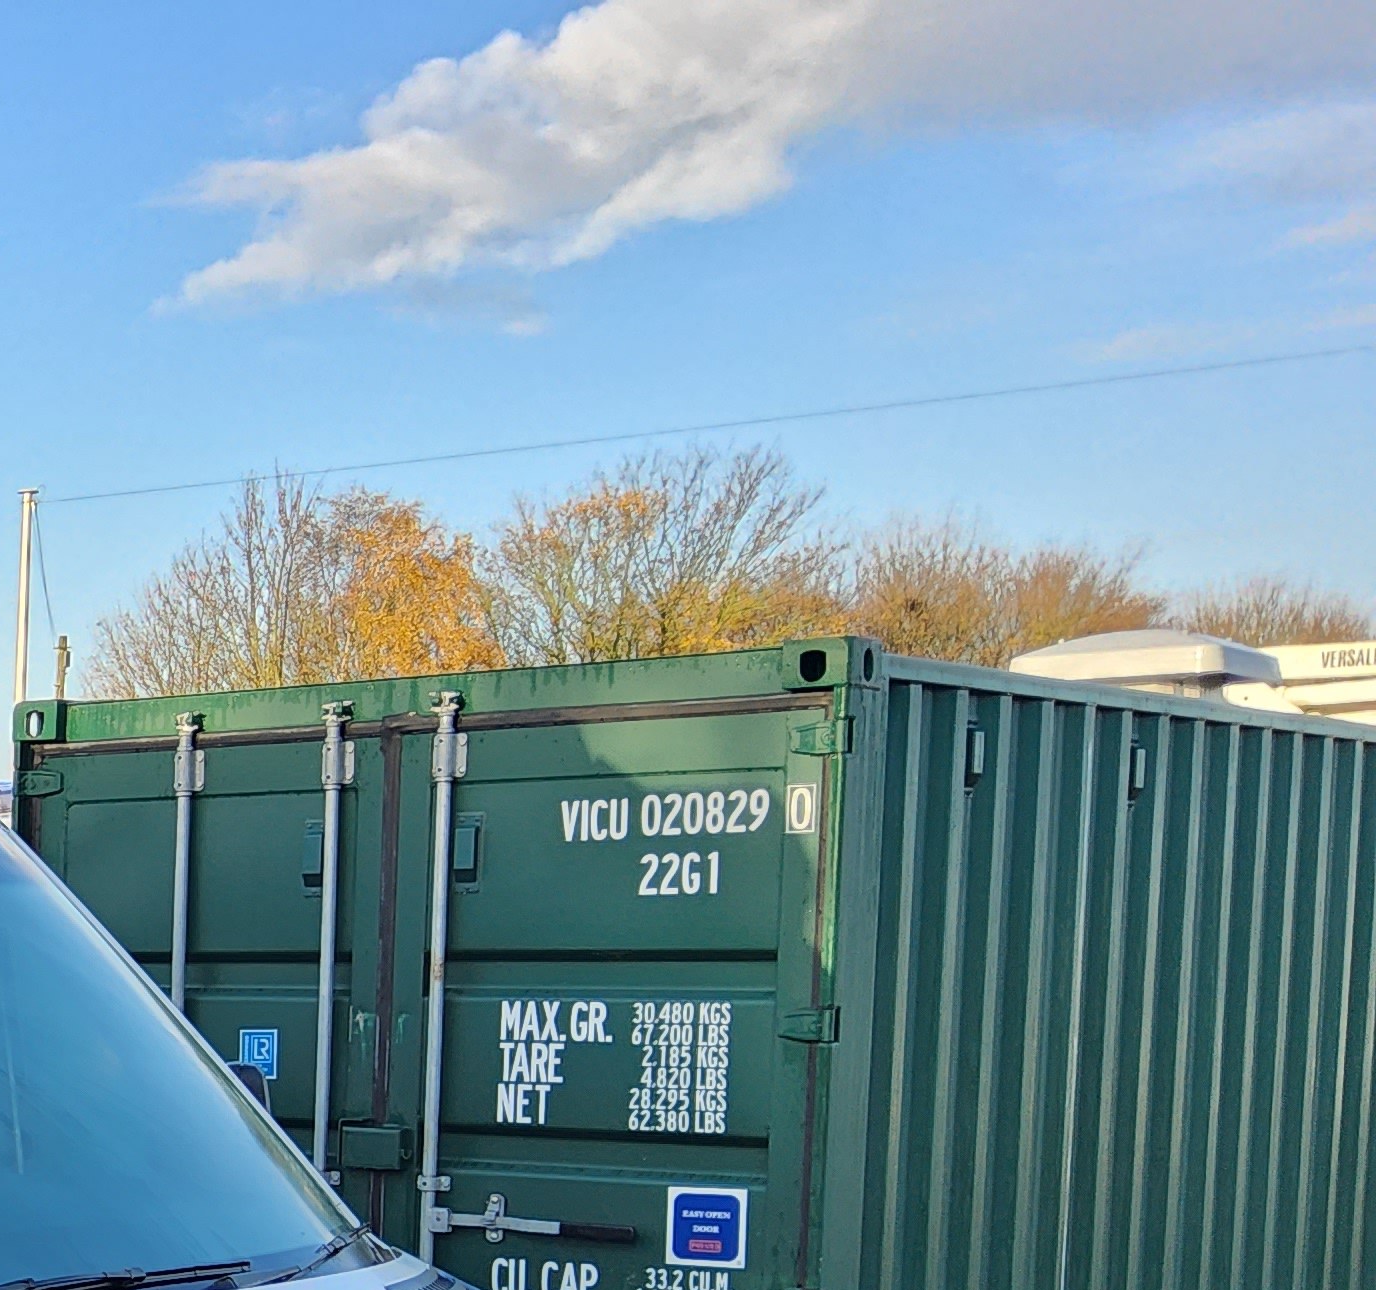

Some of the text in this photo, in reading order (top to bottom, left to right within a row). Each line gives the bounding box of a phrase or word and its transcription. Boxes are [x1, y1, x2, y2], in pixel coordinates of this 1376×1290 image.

[561, 787, 812, 842] VICU 020829 0
[638, 851, 719, 896] 22G1
[500, 1000, 613, 1042] MAX. GR.
[632, 1002, 732, 1025] 30.480 KGS
[631, 1024, 729, 1046] 67.200 LBS
[499, 1042, 565, 1083] TARE
[641, 1046, 729, 1068] 2.185 KGS
[640, 1067, 727, 1090] 4.820 LBS
[496, 1083, 551, 1125] NET
[628, 1088, 727, 1112] 28.295 KGS
[628, 1110, 726, 1134] 62.380 LBS
[681, 1209, 731, 1220] EASY OPEN
[645, 1267, 684, 1290] 33.2
